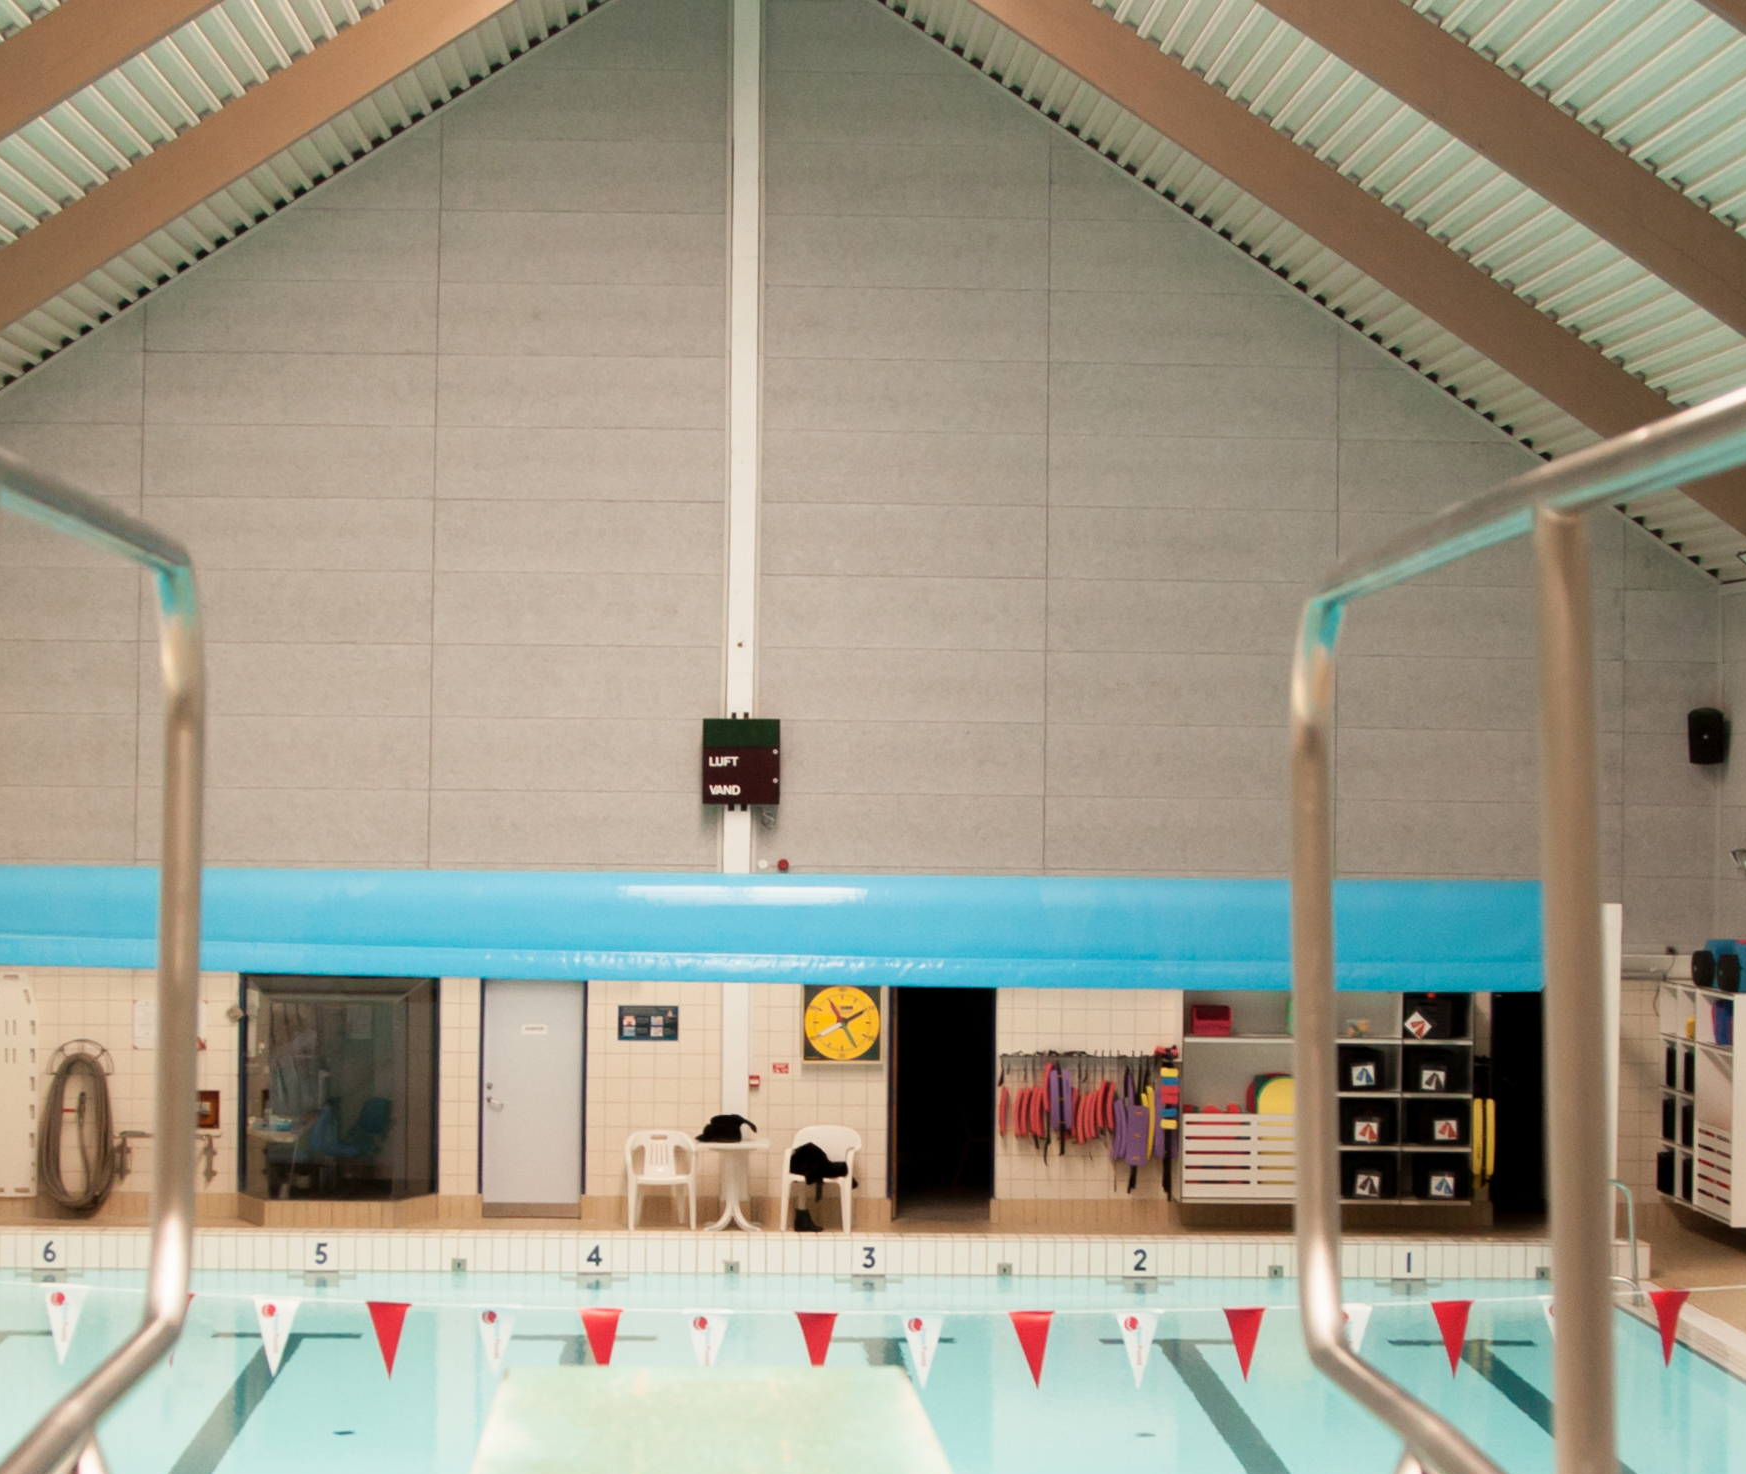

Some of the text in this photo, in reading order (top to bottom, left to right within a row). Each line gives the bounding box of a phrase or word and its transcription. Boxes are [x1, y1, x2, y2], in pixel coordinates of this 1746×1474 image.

[708, 755, 740, 767] LUFT
[708, 784, 741, 796] VAND
[43, 1241, 56, 1263] 6
[315, 1242, 328, 1265] 5
[586, 1245, 603, 1267] 4
[862, 1246, 876, 1269] 3
[1133, 1249, 1147, 1271] 2
[1406, 1252, 1412, 1273] 1
